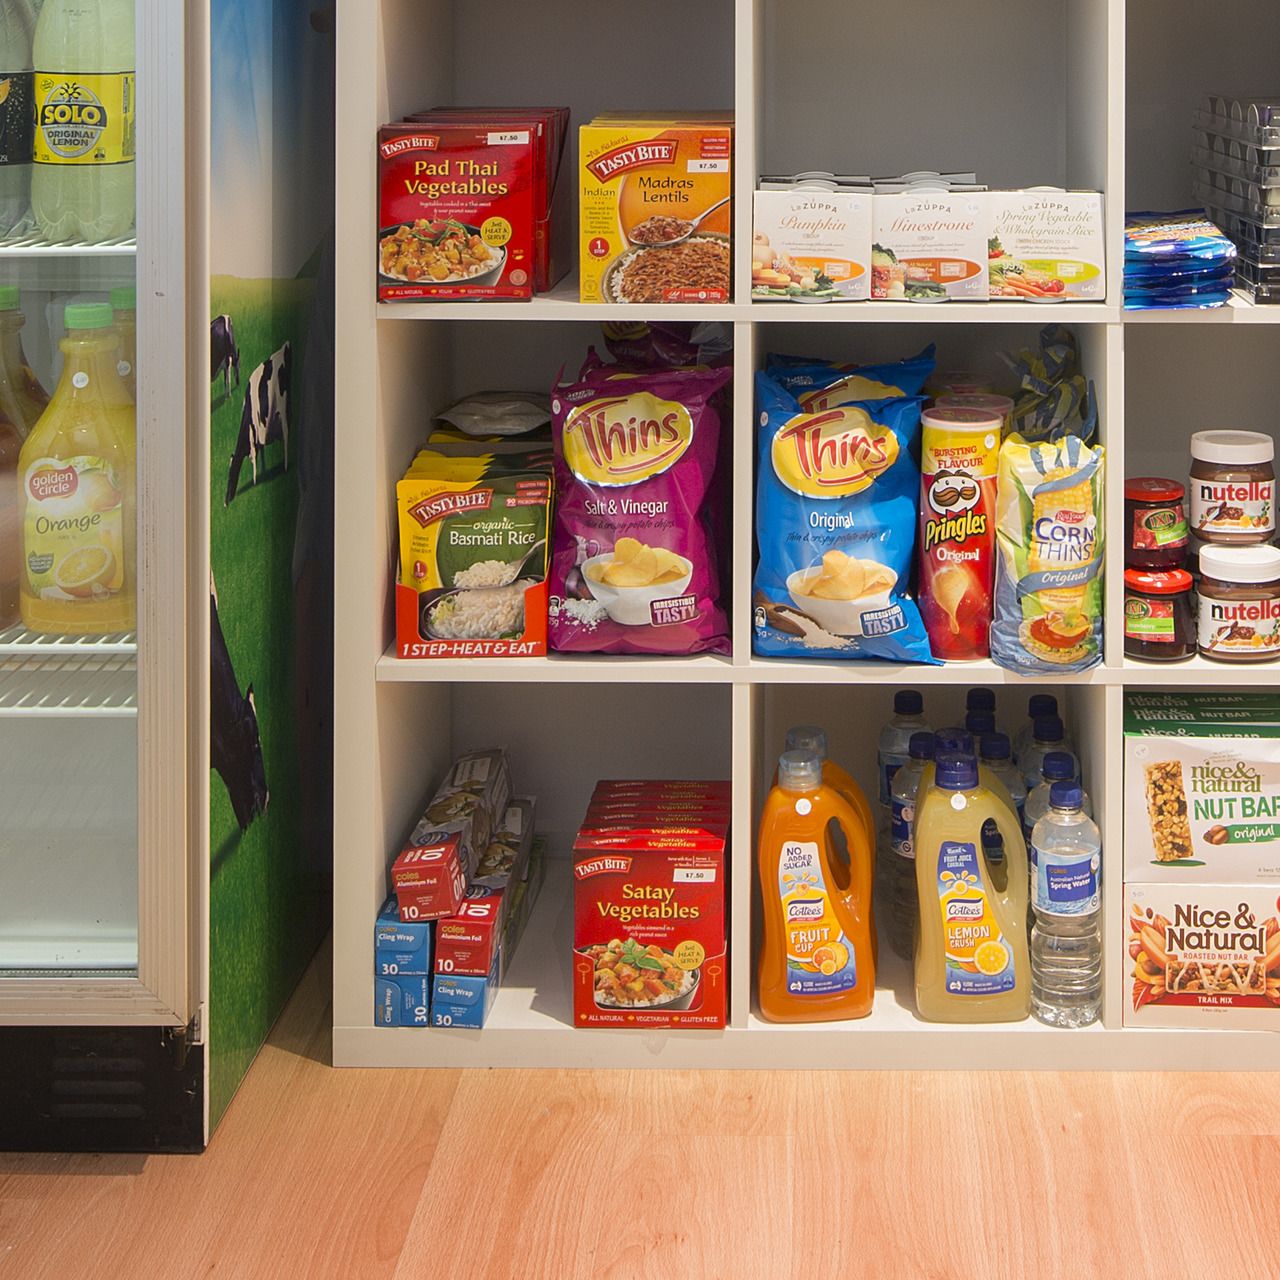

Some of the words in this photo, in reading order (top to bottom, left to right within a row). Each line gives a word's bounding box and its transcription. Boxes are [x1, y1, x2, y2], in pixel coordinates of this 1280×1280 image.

[45, 107, 101, 124] SOLO
[46, 130, 94, 141] ORIGINAL
[52, 138, 88, 147] LEMON
[414, 160, 449, 176] Pad
[456, 160, 497, 176] Thai
[597, 149, 638, 177] TASTY
[638, 145, 671, 162] BITE
[404, 179, 508, 198] Vegetables
[638, 177, 694, 189] Madras
[643, 191, 689, 203] Lentils
[779, 217, 846, 231] Pumpkin
[880, 219, 974, 233] Minestrone
[566, 401, 678, 467] Thins
[782, 411, 885, 476] Thins
[1201, 482, 1270, 501] nutella
[585, 500, 606, 514] Salt
[608, 500, 617, 514] &
[620, 500, 668, 514] Vinegar
[36, 512, 101, 534] Orange
[473, 521, 515, 531] organic
[810, 512, 854, 528] Original
[925, 512, 986, 549] Pringles
[1035, 518, 1094, 540] CORN
[450, 532, 503, 545] Basmati
[508, 532, 536, 545] Rice
[937, 548, 979, 561] Original
[1038, 542, 1093, 560] THINS
[1042, 569, 1087, 583] Original
[653, 598, 695, 609] IRRESISTIBLY
[1212, 601, 1280, 620] nutella
[655, 605, 696, 622] TASTY
[403, 644, 409, 655] 1
[509, 642, 538, 653] EAT
[1191, 774, 1261, 794] natural
[1194, 798, 1234, 820] NUT
[1234, 826, 1275, 842] original
[787, 847, 801, 856] NO
[788, 854, 812, 862] ADDED
[577, 861, 604, 875] TASTY
[605, 859, 626, 871] BITE
[784, 861, 812, 870] SUGAR
[1051, 882, 1071, 890] Spring
[1072, 879, 1090, 887] Water
[622, 885, 674, 902] Satay
[597, 903, 699, 921] Vegetables
[789, 904, 821, 919] Cottee's
[948, 904, 980, 919] Cottee's
[1175, 904, 1229, 927] Nice
[1234, 903, 1257, 929] &
[791, 930, 829, 944] FRUIT
[948, 927, 989, 939] LEMON
[796, 942, 813, 952] CUP
[950, 939, 975, 948] CRUSH
[1167, 929, 1265, 954] Natural
[438, 989, 454, 997] Cling
[455, 989, 473, 997] Wrap
